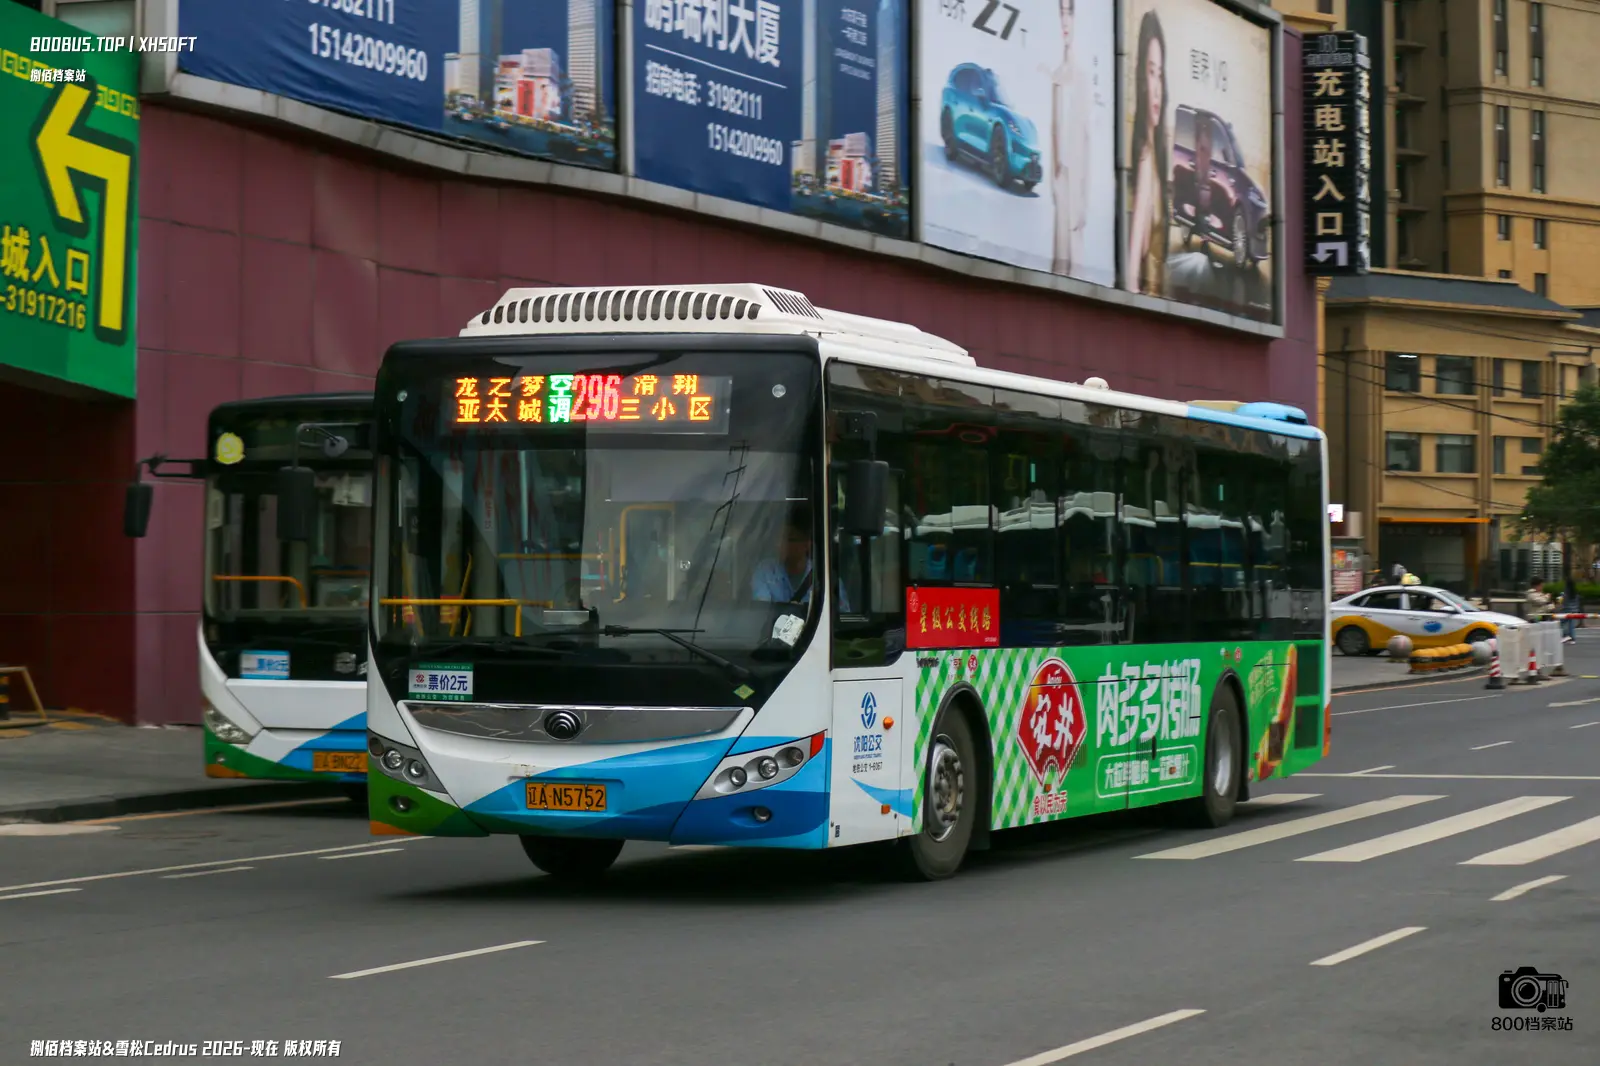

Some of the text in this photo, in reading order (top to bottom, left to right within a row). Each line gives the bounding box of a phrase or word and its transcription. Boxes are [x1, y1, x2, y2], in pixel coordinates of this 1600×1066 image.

[308, 22, 428, 82] 15142009960
[706, 80, 763, 120] 31982111
[706, 122, 783, 166] 15142009960
[1312, 67, 1346, 237] 充电站入口
[0, 224, 90, 296] 城入口
[455, 376, 545, 398] 龙之梦
[548, 374, 574, 423] 空调
[571, 374, 621, 421] 296
[634, 374, 698, 396] 滑翔
[456, 398, 542, 423] 亚太城
[619, 396, 712, 421] 三小区
[428, 673, 468, 691] 票价2元
[1096, 658, 1202, 749] 肉多多烤肠
[853, 734, 882, 753] 沈阳公交
[1030, 692, 1074, 761] 安井
